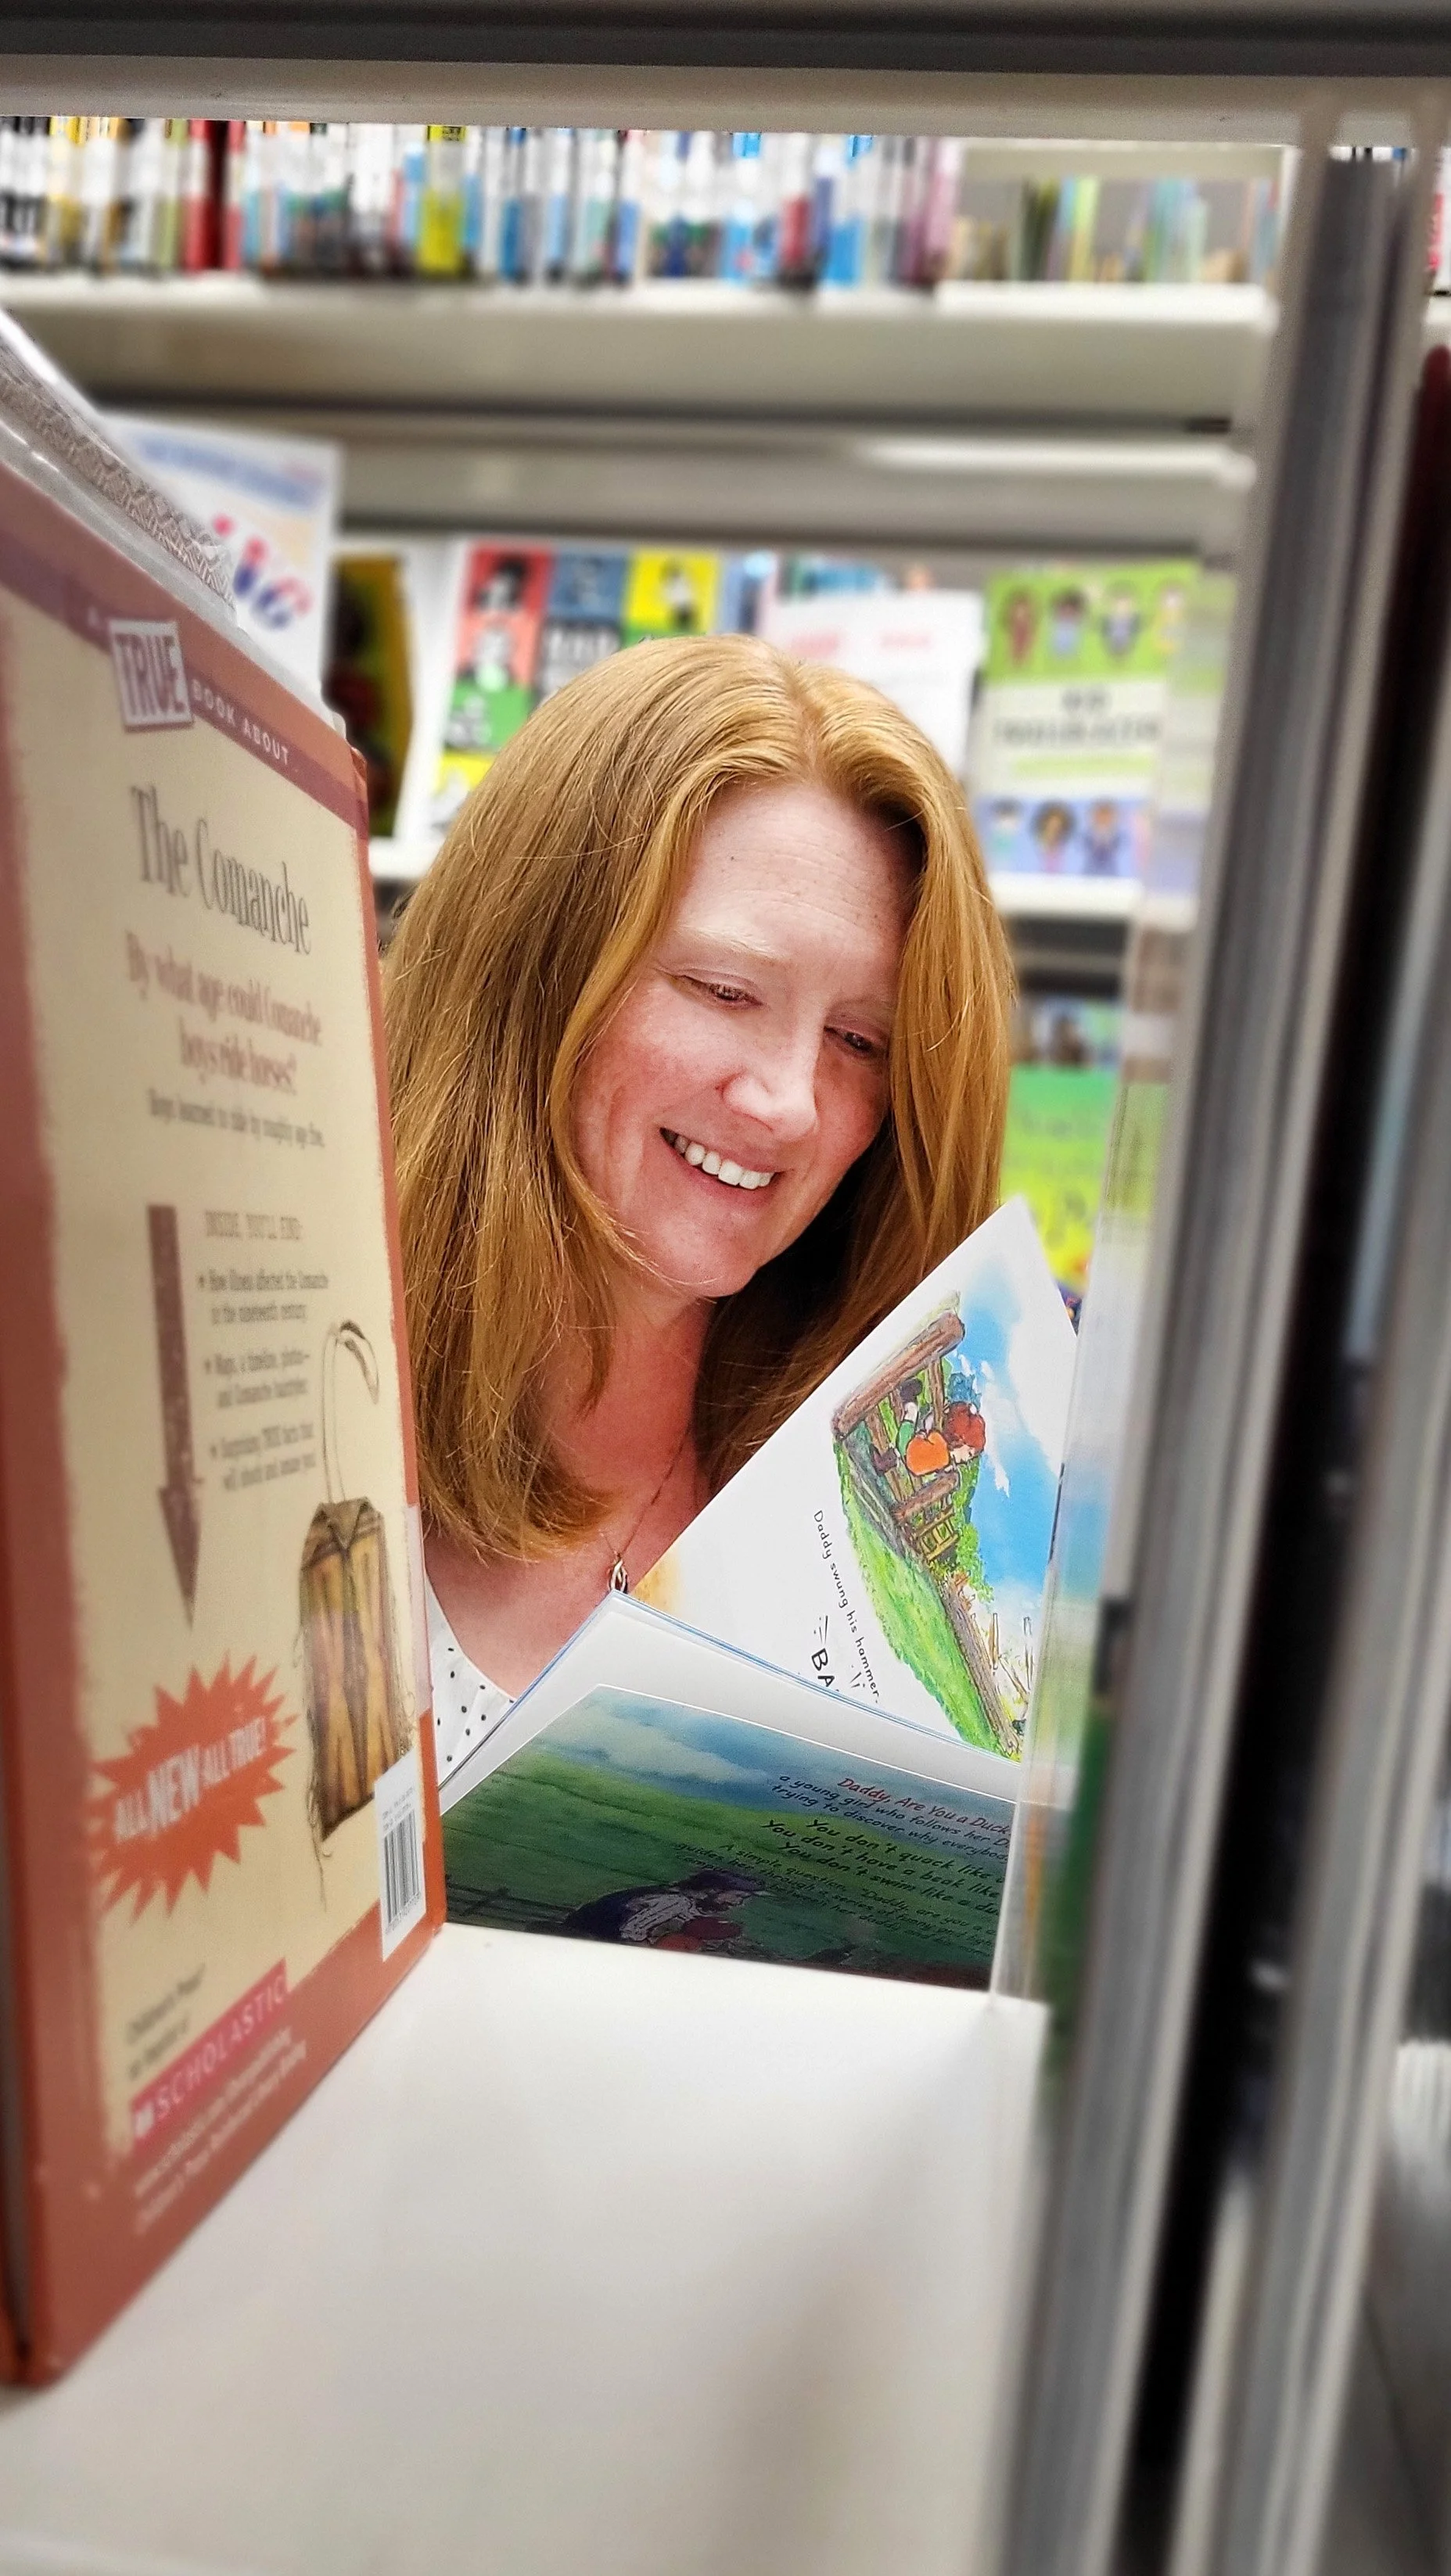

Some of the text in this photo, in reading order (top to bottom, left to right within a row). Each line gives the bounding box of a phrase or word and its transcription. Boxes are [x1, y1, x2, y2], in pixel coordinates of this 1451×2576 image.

[114, 632, 187, 716] TRUE
[191, 678, 236, 727] BOOK
[241, 717, 289, 766] ABOUT
[131, 783, 312, 956] The Comanche
[813, 1509, 880, 1703] Daddy swung his hammer.
[810, 1647, 839, 1692] BA
[114, 1789, 149, 1844] ALL
[147, 1743, 200, 1838] NEW
[203, 1740, 231, 1790] ALL
[772, 1785, 819, 1806] trying
[823, 1803, 839, 1812] to
[844, 1810, 905, 1833] discover
[908, 1829, 939, 1845] why
[790, 1779, 840, 1800] young
[843, 1797, 871, 1810] girl
[875, 1806, 906, 1821] who
[910, 1814, 962, 1835] follows
[964, 1830, 991, 1842] her
[838, 1778, 1011, 1835] Daddy, Are You a Duck
[735, 1850, 783, 1868] simple
[760, 1819, 797, 1839] You
[801, 1835, 853, 1856] don't
[855, 1853, 899, 1871] have
[919, 1871, 967, 1889] beak
[968, 1882, 1000, 1898] like
[779, 1841, 813, 1860] You
[816, 1856, 868, 1877] don't
[869, 1875, 917, 1891] swim
[920, 1885, 954, 1901] like
[975, 1903, 1000, 1916] du
[806, 1819, 842, 1838] You
[845, 1833, 898, 1854] don't
[899, 1849, 955, 1871] quack
[957, 1864, 993, 1879] like
[156, 1972, 288, 2121] SCHOLASTIC
